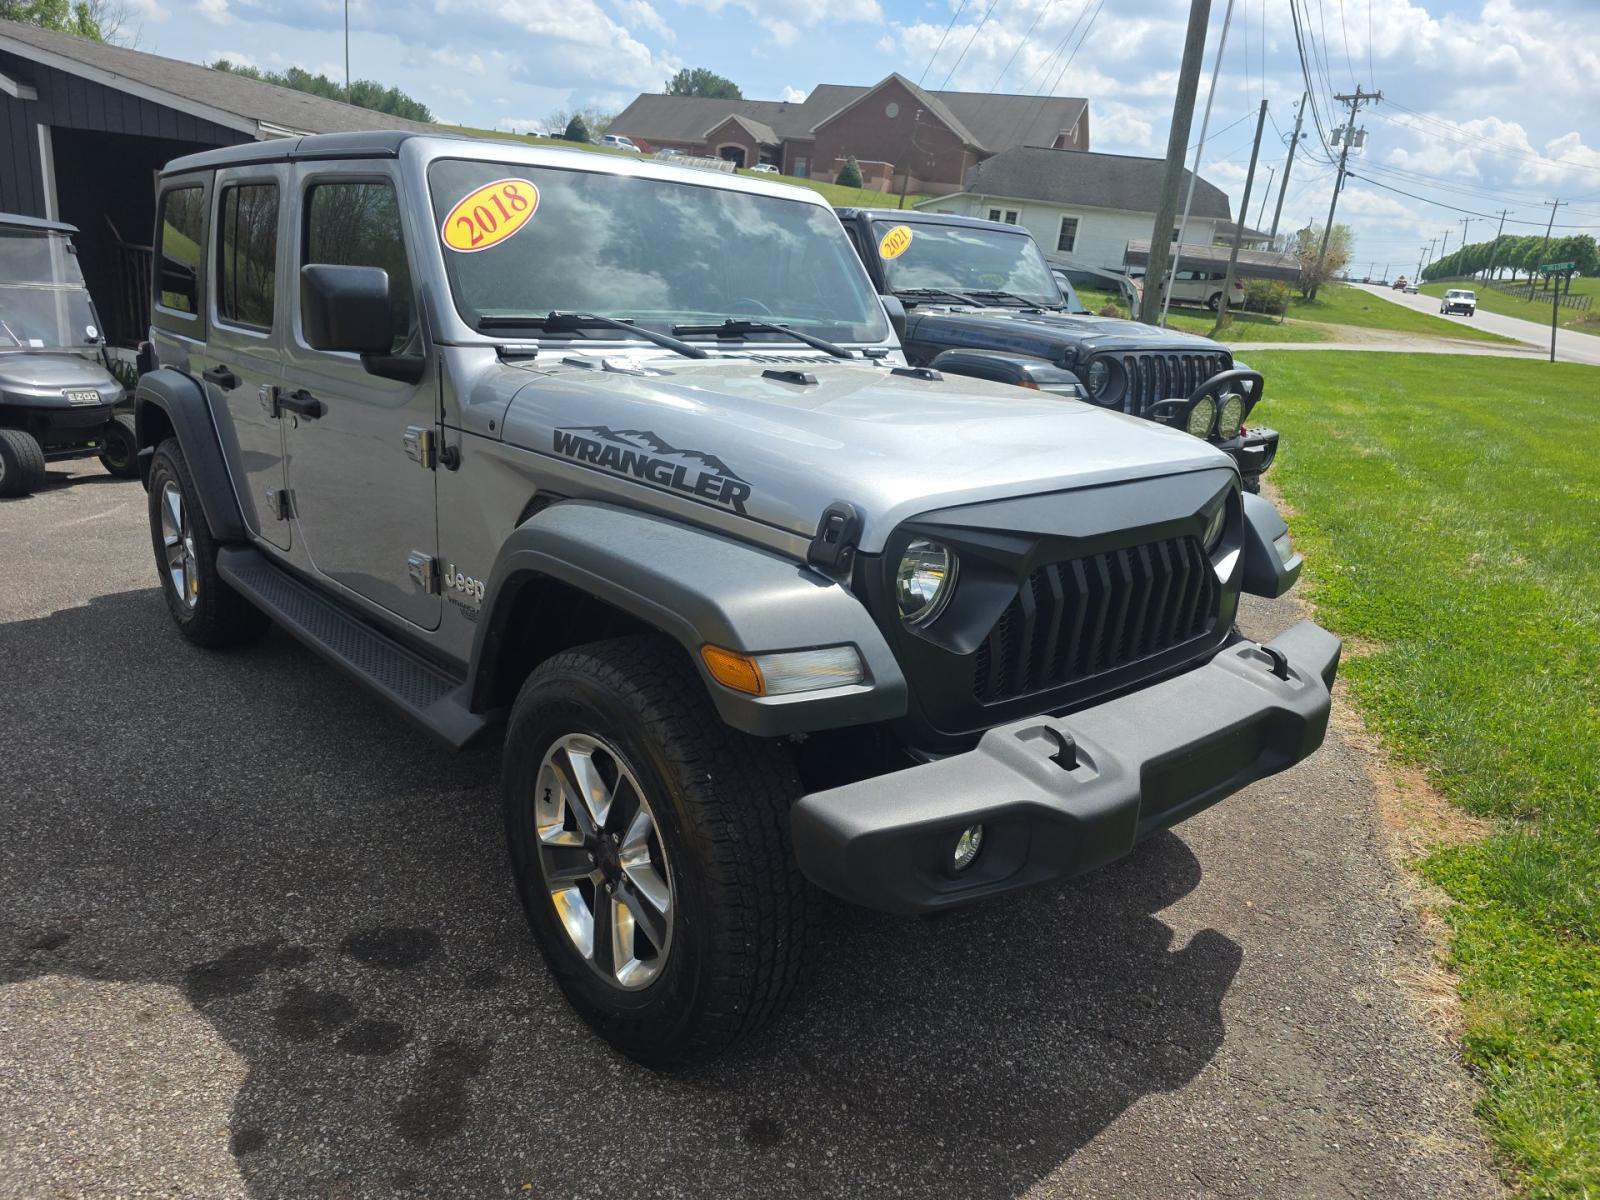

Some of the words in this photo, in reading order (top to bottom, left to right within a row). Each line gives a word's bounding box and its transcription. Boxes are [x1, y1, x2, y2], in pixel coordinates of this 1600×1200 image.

[456, 184, 528, 246] 2018
[884, 229, 909, 256] 2021
[553, 429, 751, 515] WRANGLER
[444, 564, 485, 602] Jeep
